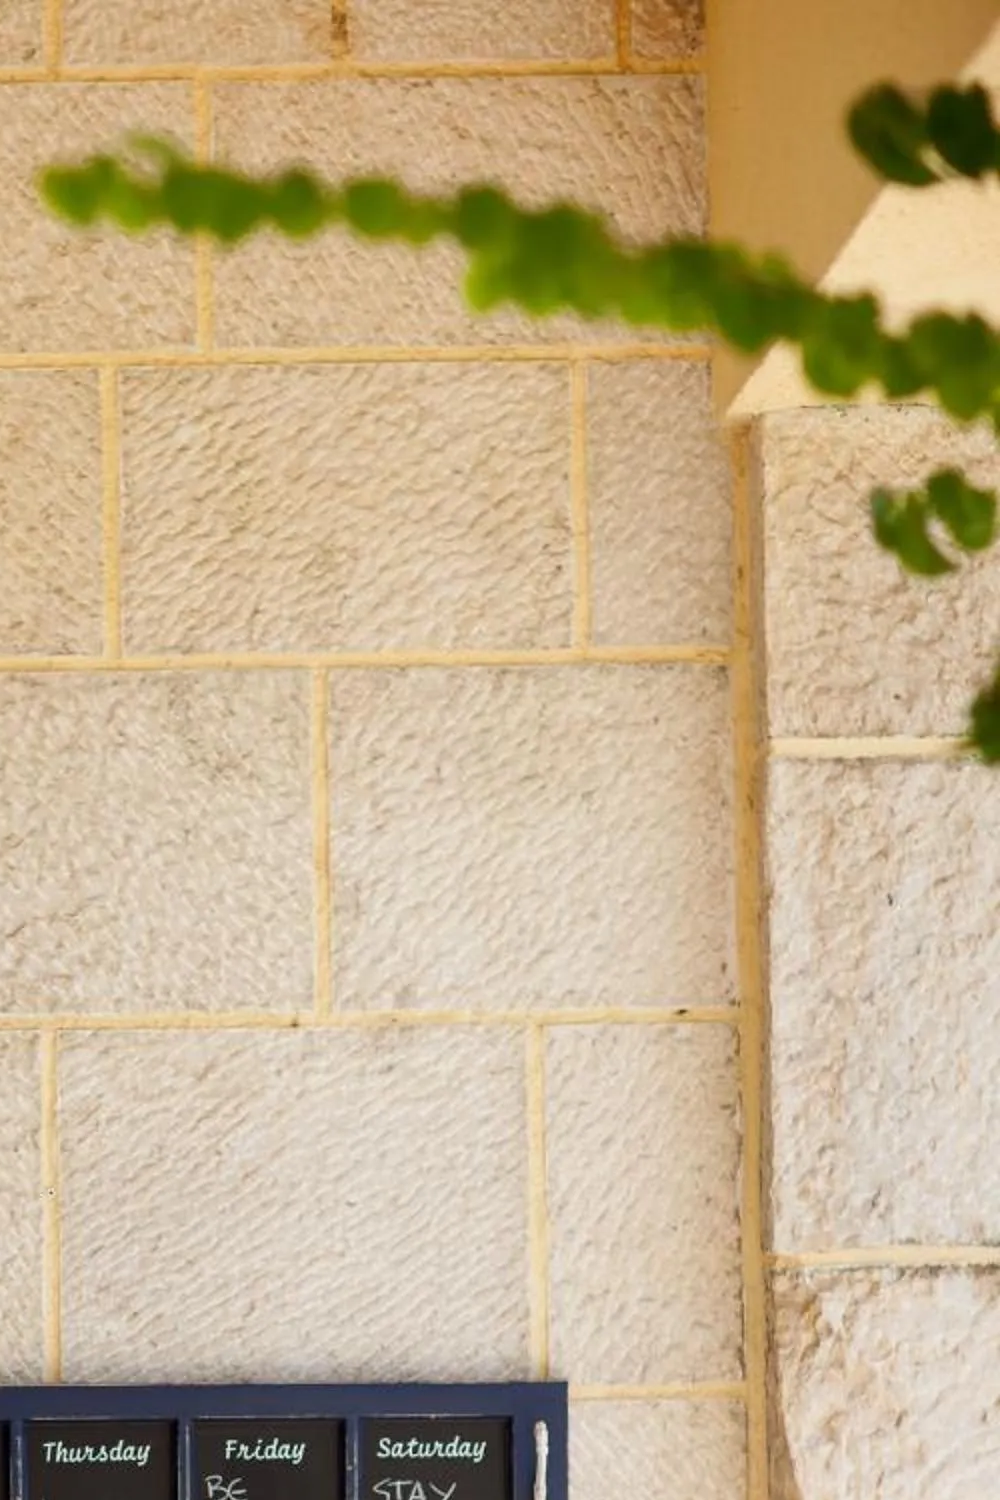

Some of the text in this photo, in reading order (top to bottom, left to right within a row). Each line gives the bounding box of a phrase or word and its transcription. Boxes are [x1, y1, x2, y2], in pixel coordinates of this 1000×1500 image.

[43, 1440, 150, 1466] Thursday
[225, 1438, 305, 1464] Friday
[377, 1436, 487, 1462] Saturday
